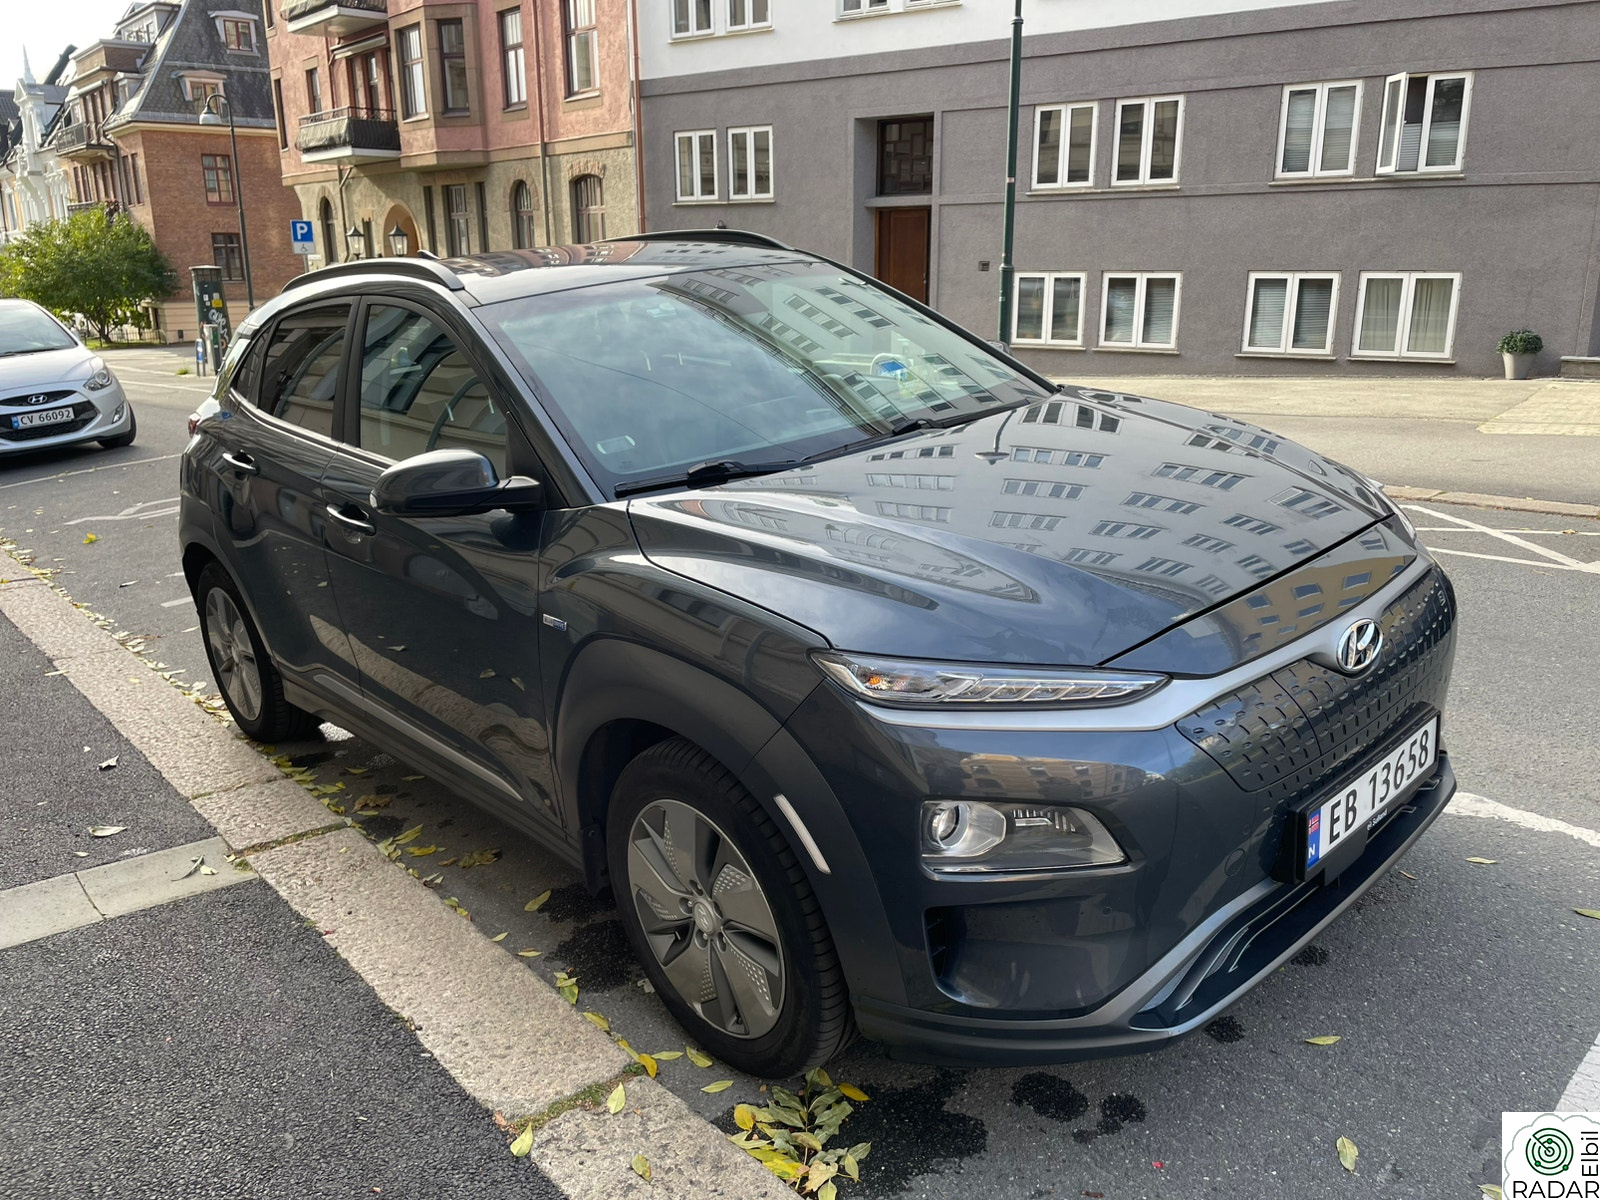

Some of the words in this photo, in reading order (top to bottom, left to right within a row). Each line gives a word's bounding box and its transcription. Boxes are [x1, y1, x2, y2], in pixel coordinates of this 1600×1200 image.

[296, 223, 308, 240] P
[20, 414, 34, 425] CV
[38, 409, 72, 423] 66092
[1329, 788, 1358, 845] EB
[1369, 729, 1429, 811] 13658
